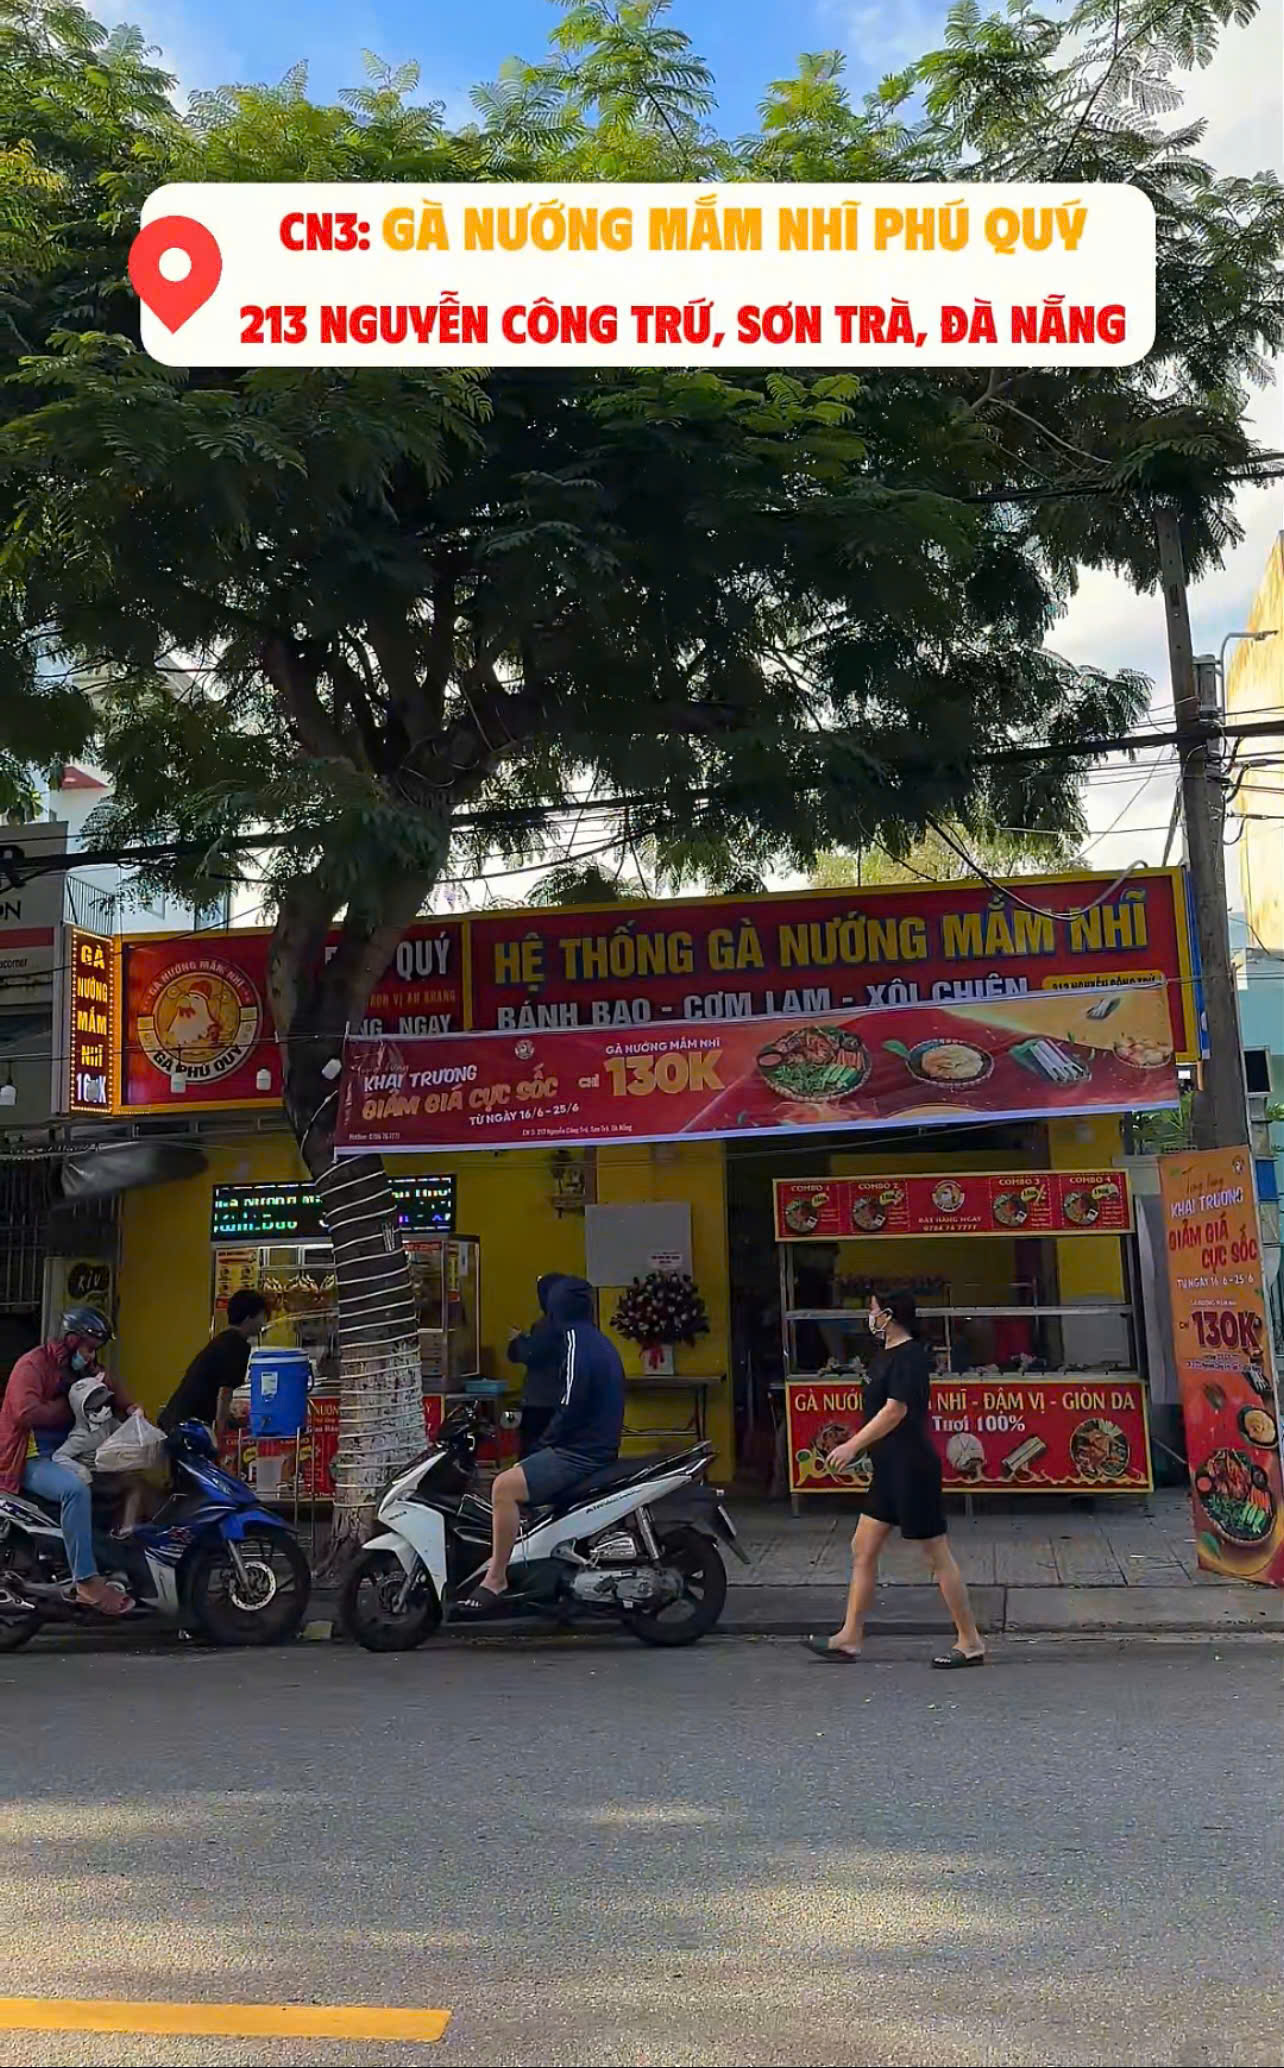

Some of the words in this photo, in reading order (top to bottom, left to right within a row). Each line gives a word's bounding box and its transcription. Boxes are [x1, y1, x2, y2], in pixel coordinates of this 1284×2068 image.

[495, 932, 545, 992] HỆ
[559, 920, 694, 980] THỐNG
[708, 917, 765, 970] GÀ
[779, 910, 928, 967] NƯỚNG
[943, 893, 1055, 958] MẮM
[1069, 889, 1149, 952] NHĨ
[81, 944, 105, 969] GÀ
[396, 931, 450, 981] QUÝ
[77, 976, 108, 1003] NƯỚNG
[497, 1001, 579, 1030] BÁNH
[592, 998, 652, 1026] BAO
[683, 991, 751, 1019] CƠM
[866, 978, 919, 1007] XÔI
[77, 1006, 107, 1036] MẮM
[399, 1013, 451, 1036] NGAY
[81, 1044, 103, 1067] NHĨ
[605, 1042, 623, 1055] GÀ
[625, 1040, 668, 1054] NƯỚNG
[669, 1036, 698, 1051] MẮM
[700, 1037, 721, 1049] NHĨ
[153, 1050, 174, 1072] GÀ
[602, 1049, 726, 1097] 130K
[364, 1073, 403, 1092] KHAI
[424, 1083, 463, 1113] GIÁ
[468, 1083, 512, 1112] CỰC
[515, 1063, 559, 1101] SỐC
[469, 1113, 487, 1126] TỪ
[486, 1109, 518, 1124] NGÀY
[520, 1107, 544, 1119] 16/6
[553, 1103, 580, 1115] 25/6
[999, 1178, 1033, 1186] COMBO
[1170, 1198, 1196, 1218] KHAI
[1168, 1218, 1202, 1251] GIẢM
[1205, 1211, 1229, 1244] GIÁ
[1201, 1244, 1228, 1274] CỰC
[1230, 1224, 1258, 1264] SỐC
[1191, 1310, 1260, 1348] 130K
[794, 1388, 818, 1412] GÀ
[823, 1387, 863, 1412] NƯỚ
[937, 1388, 967, 1411] NHĨ
[983, 1386, 1024, 1414] ĐẬM
[1028, 1391, 1045, 1415] VỊ
[1062, 1386, 1105, 1411] GIÒN
[1111, 1391, 1136, 1410] DA
[932, 1414, 970, 1432] Tươi
[977, 1414, 1026, 1432] 100%
